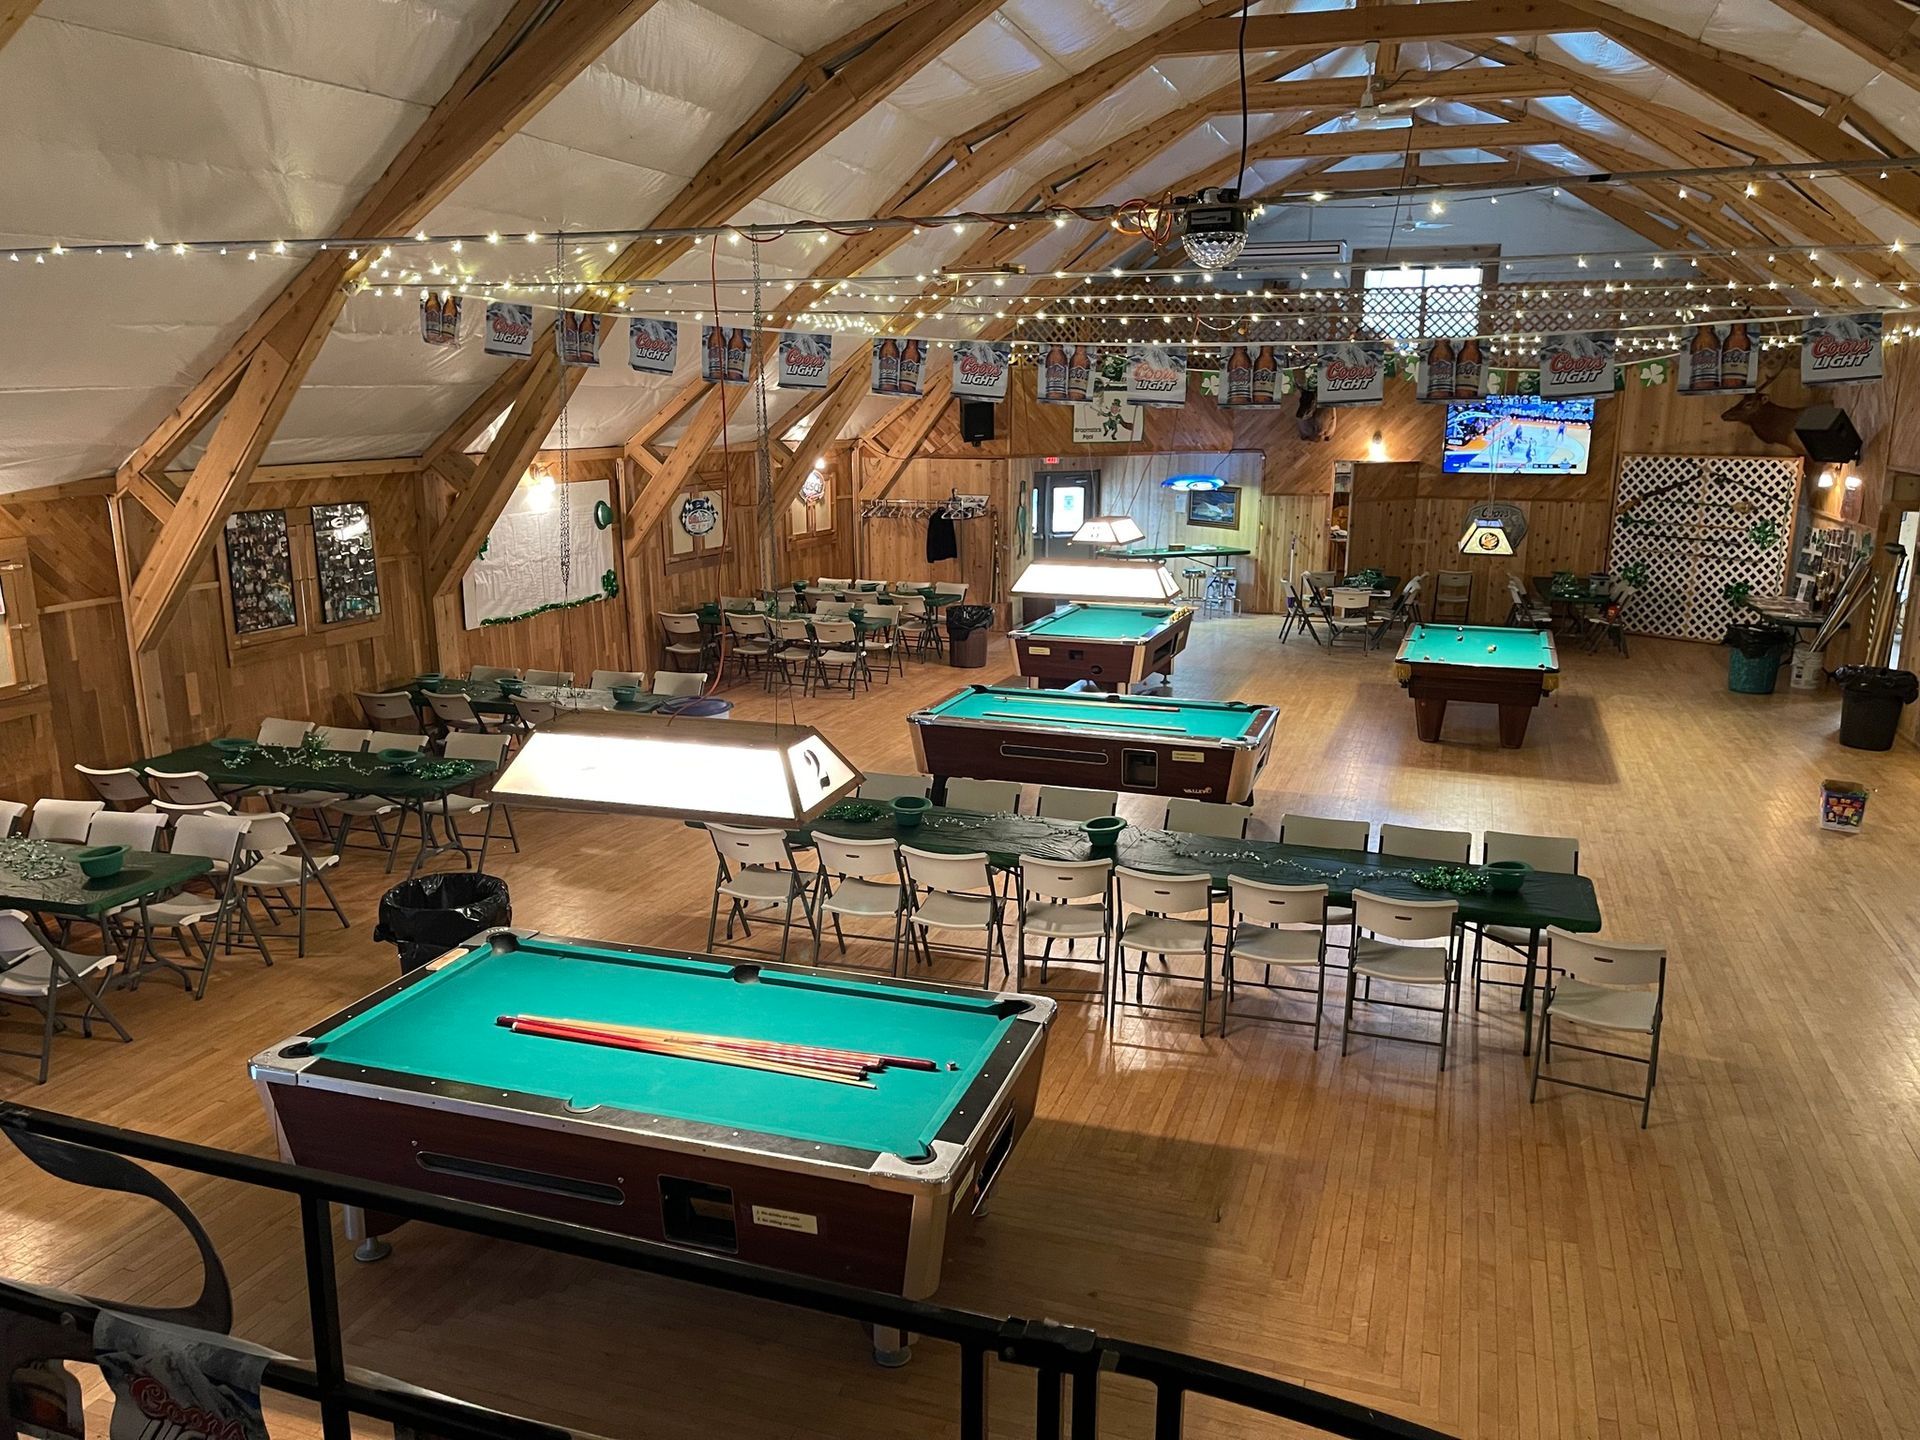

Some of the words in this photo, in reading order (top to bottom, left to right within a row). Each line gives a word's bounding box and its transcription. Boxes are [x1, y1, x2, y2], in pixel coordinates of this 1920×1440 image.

[493, 332, 526, 345] LIGHT
[635, 332, 672, 351] Coors
[1812, 332, 1873, 359] Coors
[636, 348, 669, 361] LIGHT
[785, 348, 825, 367] Coors
[1551, 350, 1607, 374] Coors
[1812, 352, 1870, 370] LIGHT
[786, 364, 823, 377] LIGHT
[960, 354, 1002, 377] Coors
[1133, 362, 1178, 381] Coors
[1326, 360, 1377, 381] Coors
[960, 373, 1000, 386] LIGHT
[1135, 379, 1176, 391] LIGHT
[1327, 377, 1373, 392] LIGHT
[1550, 368, 1603, 385] LIGHT
